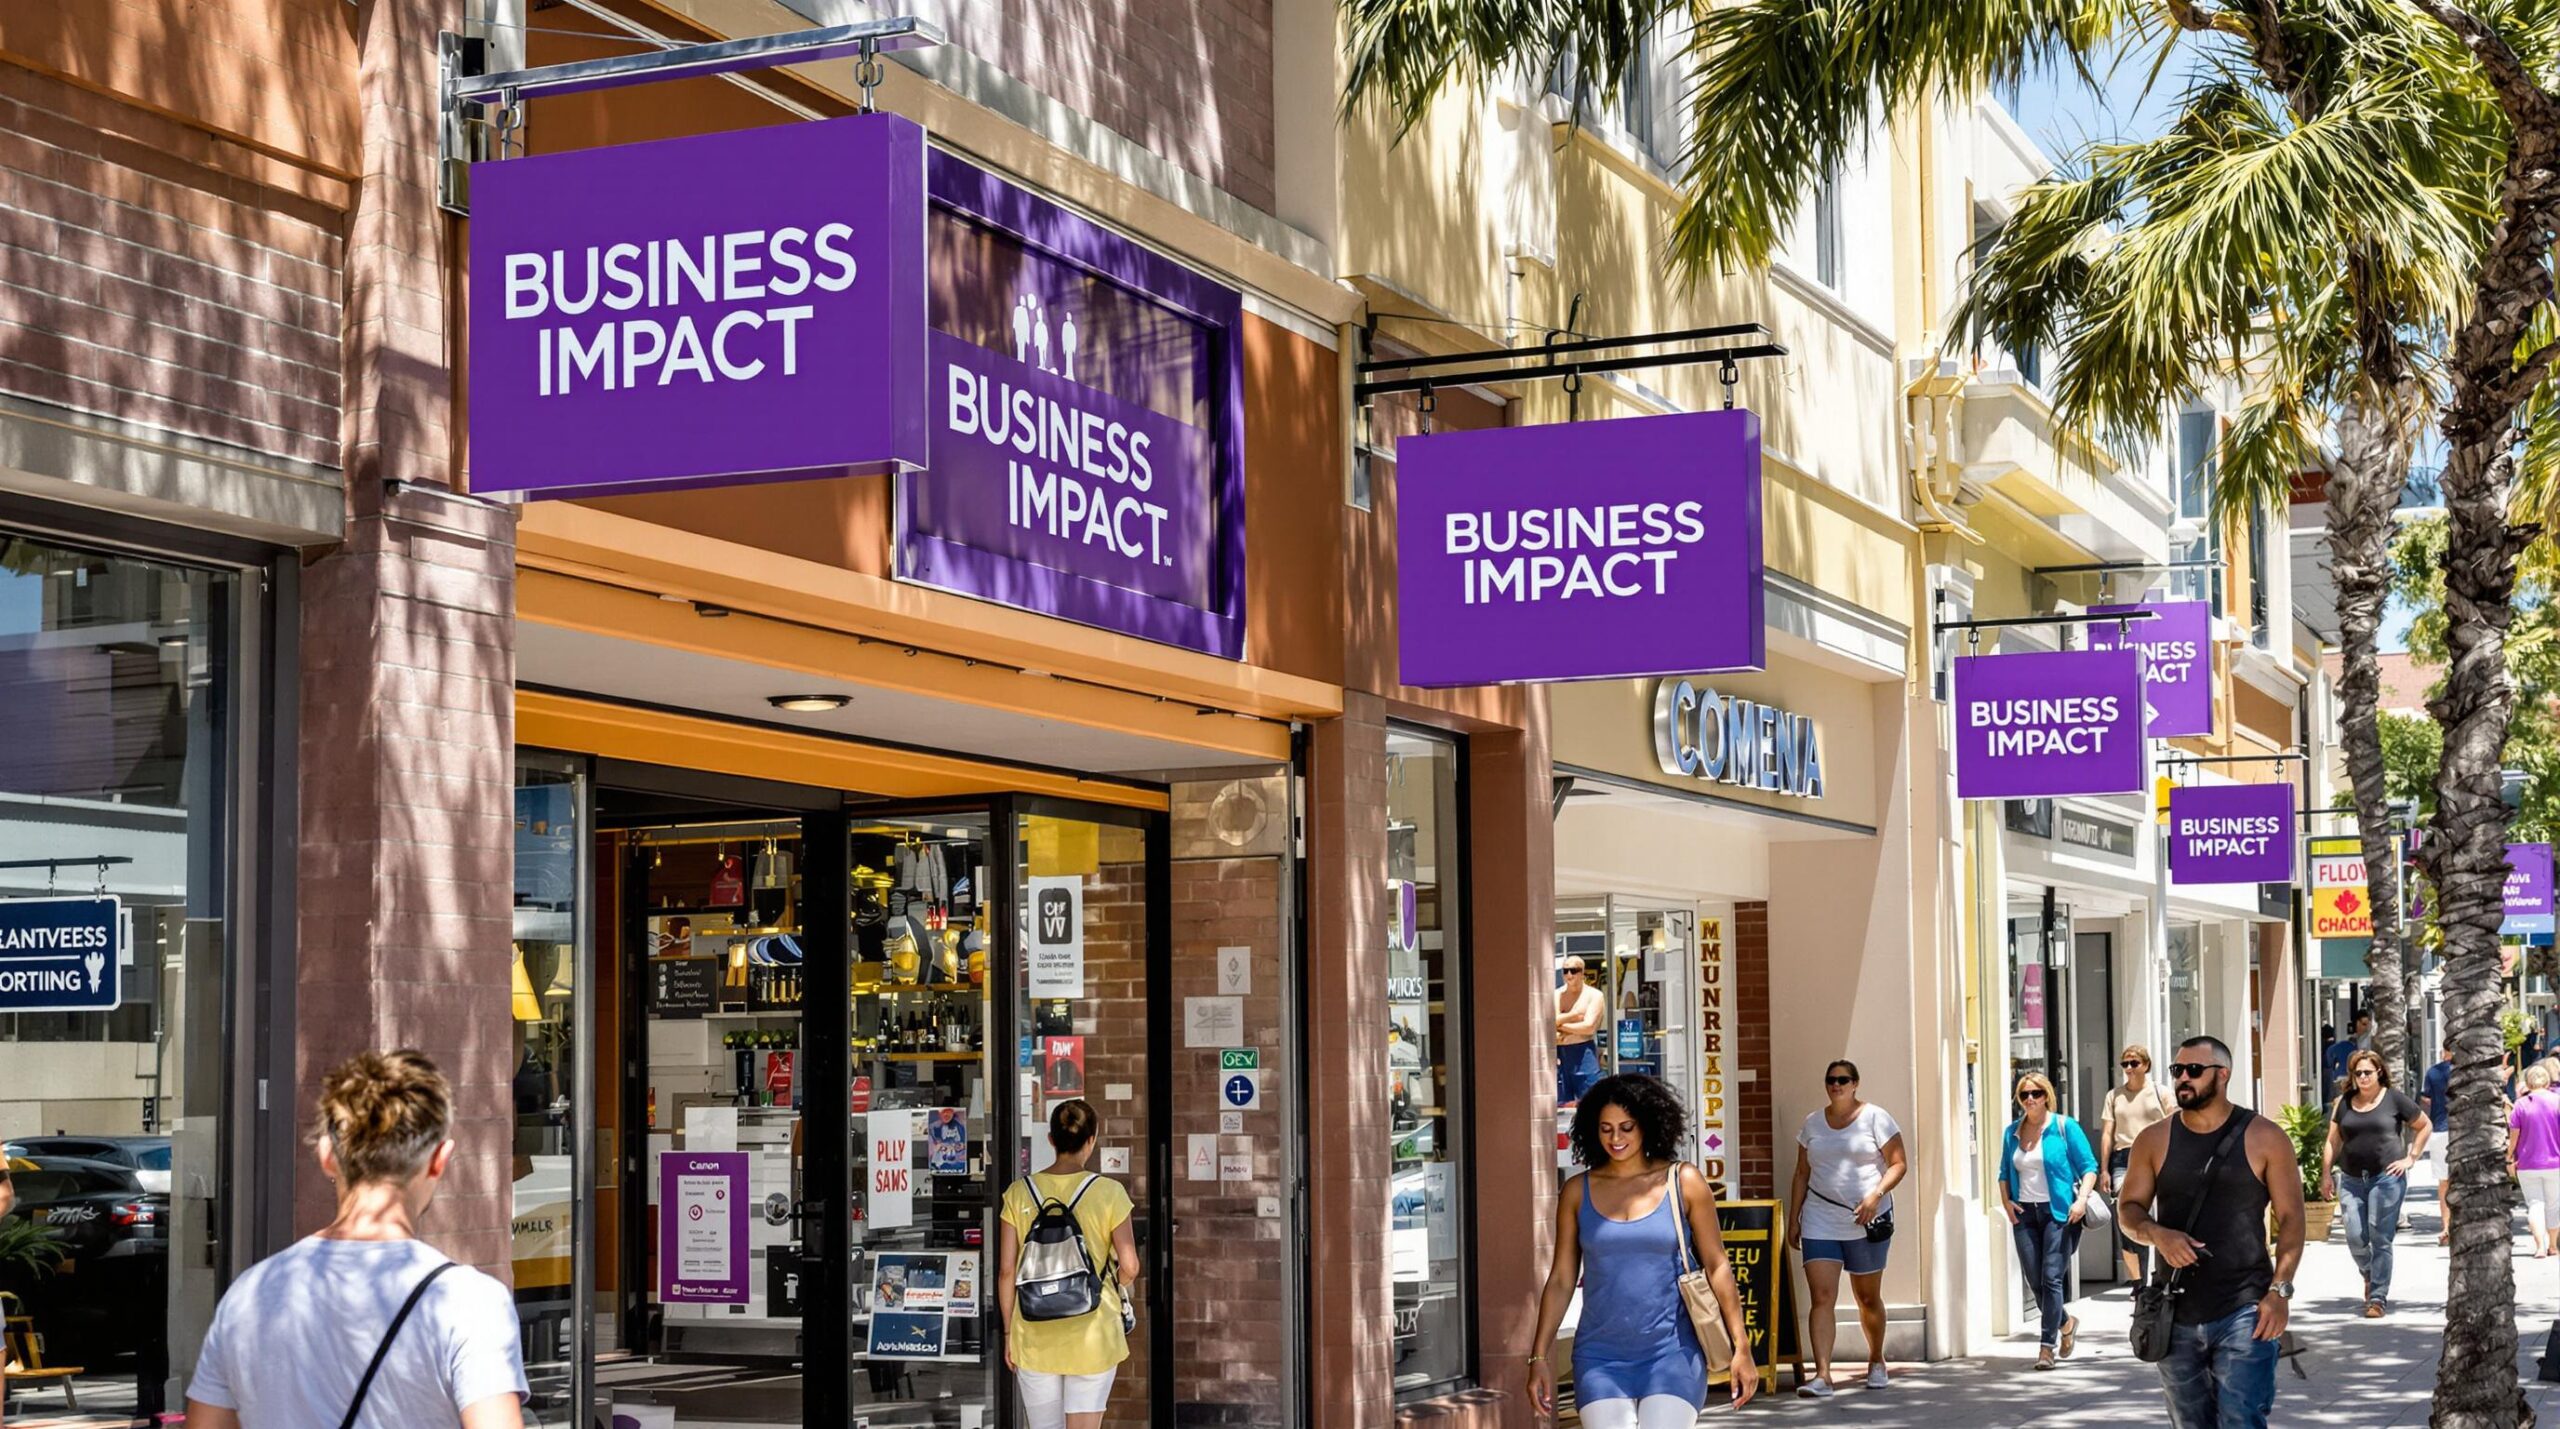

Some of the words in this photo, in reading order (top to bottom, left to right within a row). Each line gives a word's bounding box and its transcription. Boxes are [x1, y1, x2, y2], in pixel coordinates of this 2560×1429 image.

[505, 223, 857, 320] BUSINESS
[539, 306, 814, 396] IMPACT
[949, 363, 1153, 492] BUSINESS
[1008, 459, 1169, 566] IMPACT
[1446, 501, 1705, 554] BUSINESS
[1464, 550, 1678, 604] IMPACT
[2145, 662, 2192, 683] ACT
[1971, 696, 2119, 727] BUSINESS
[1654, 678, 1824, 799] COMENA
[1988, 726, 2109, 757] IMPACT
[2180, 816, 2280, 836] BUSINESS
[2189, 836, 2270, 857] IMPACT
[2318, 917, 2373, 932] CHACH
[877, 1140, 906, 1161] PLLY
[875, 1169, 908, 1193] SAWS
